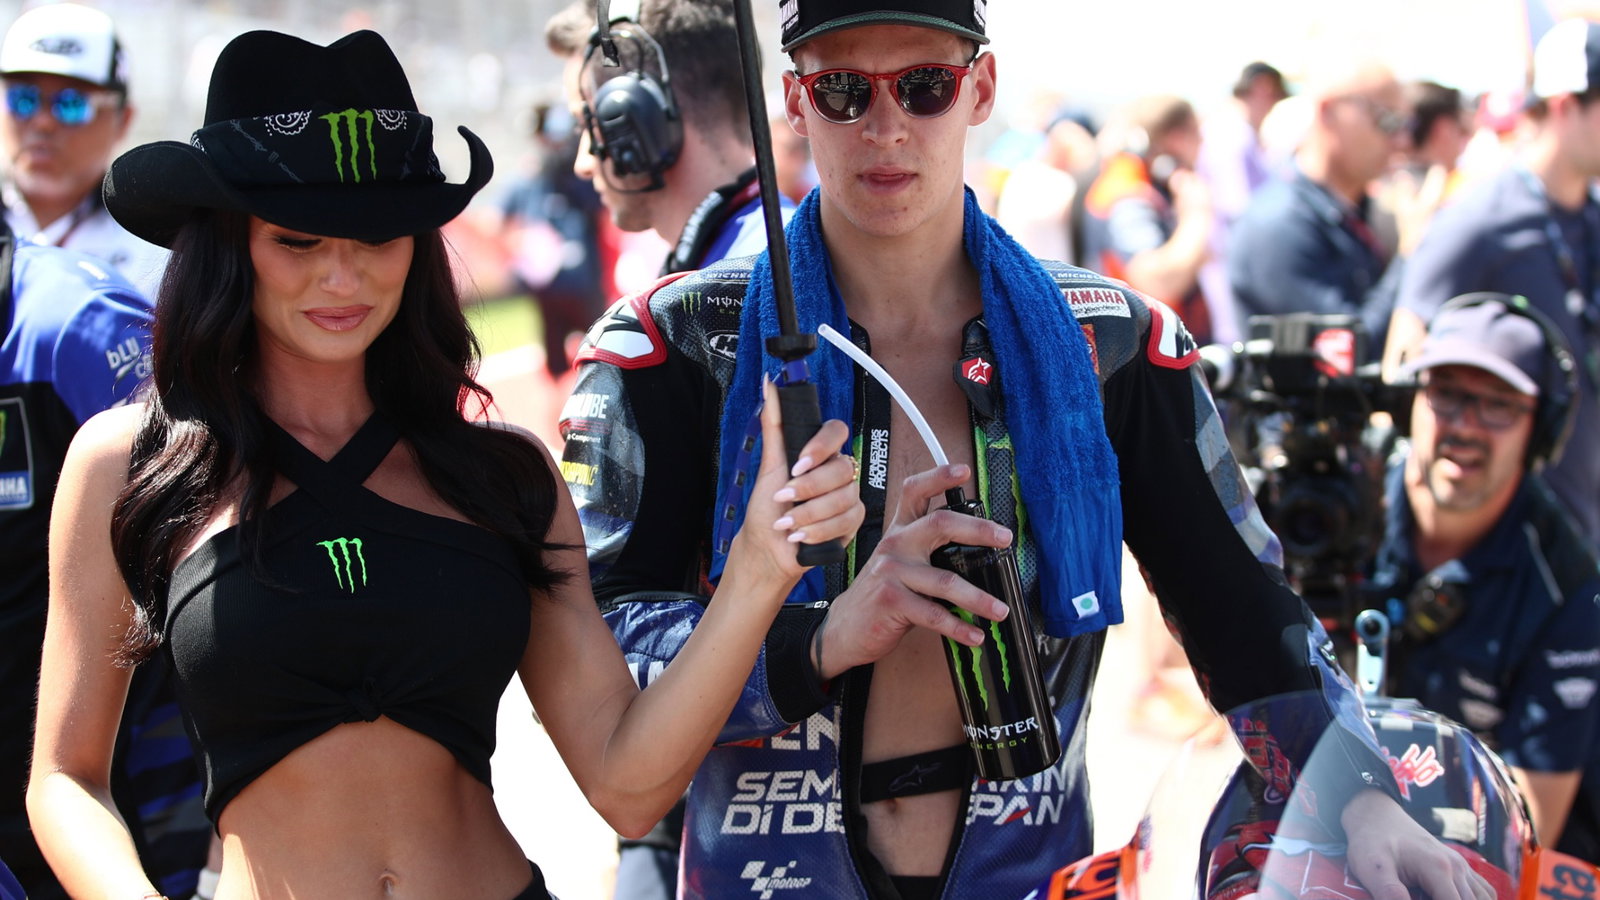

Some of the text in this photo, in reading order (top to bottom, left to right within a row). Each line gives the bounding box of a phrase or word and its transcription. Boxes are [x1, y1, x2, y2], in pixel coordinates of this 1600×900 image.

[875, 429, 889, 490] PROTECTS
[970, 737, 1028, 750] ENERGY
[731, 769, 841, 802] SEM
